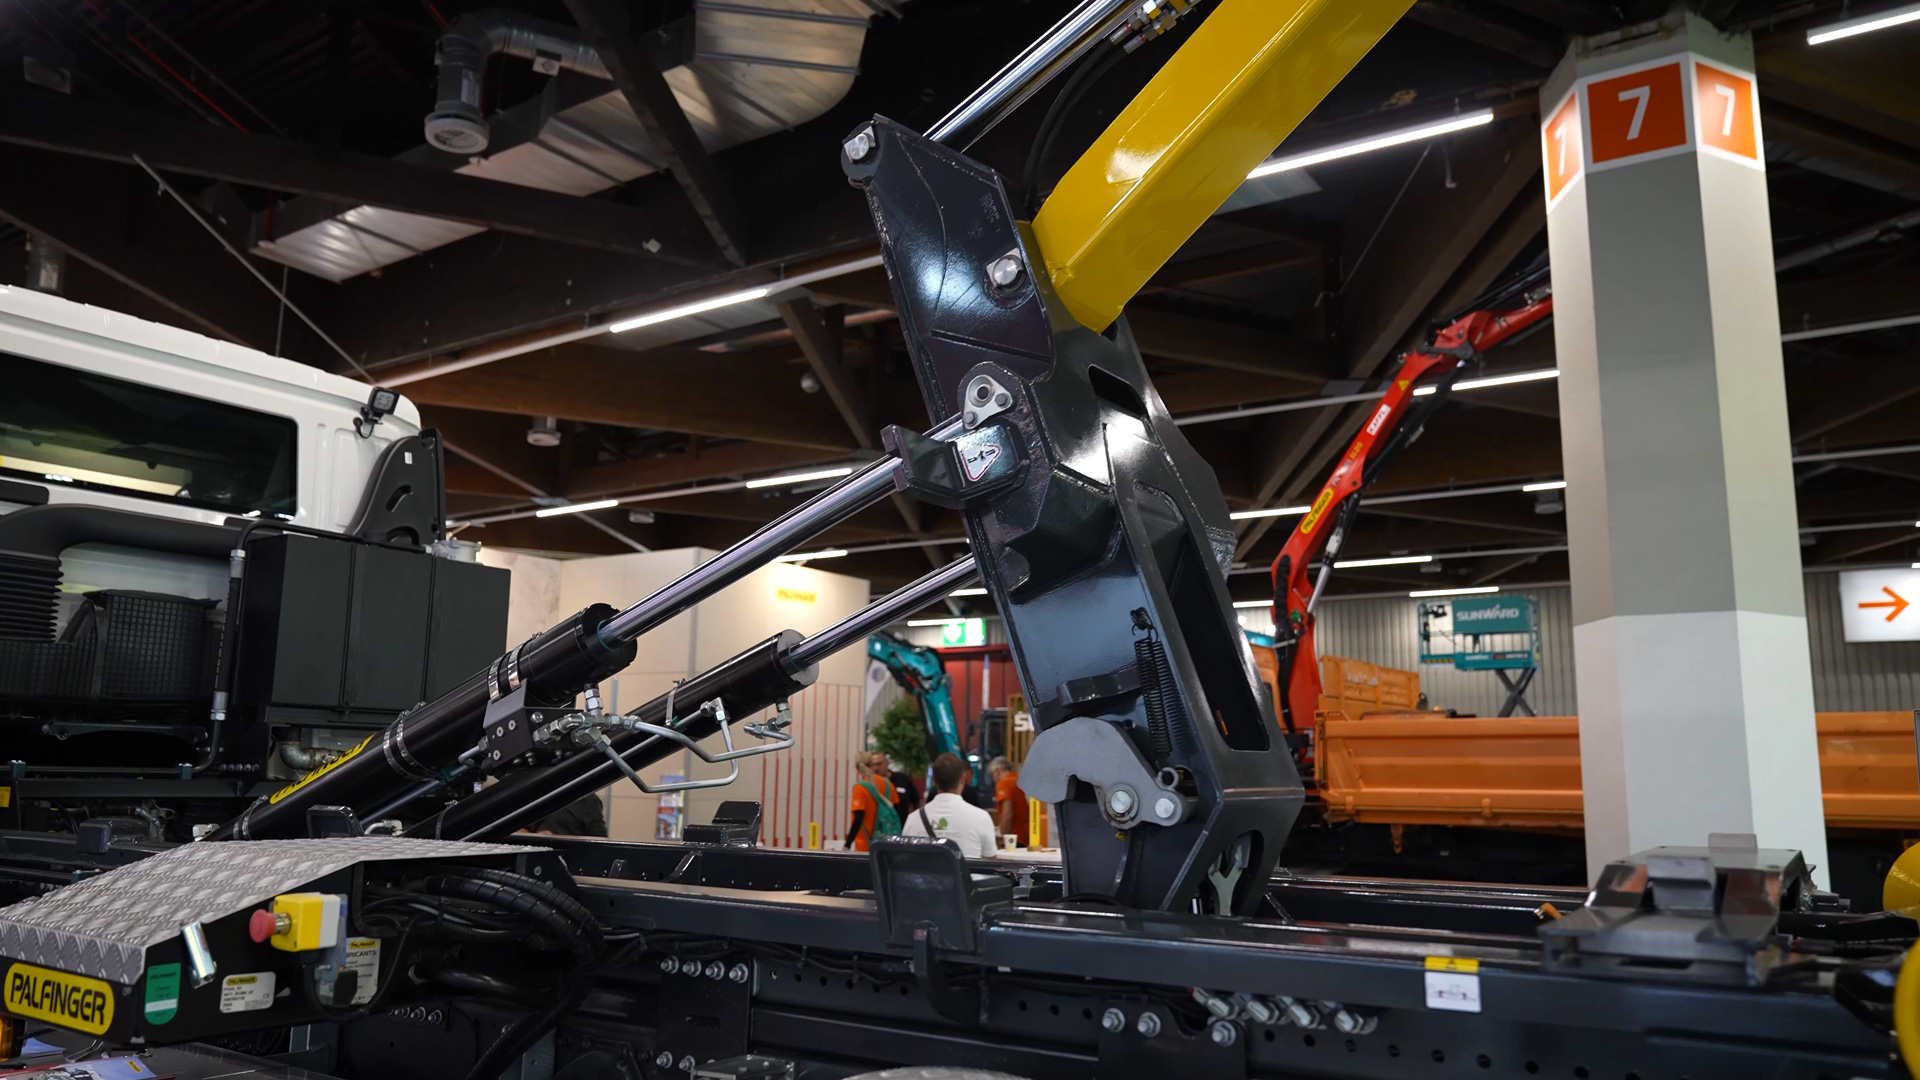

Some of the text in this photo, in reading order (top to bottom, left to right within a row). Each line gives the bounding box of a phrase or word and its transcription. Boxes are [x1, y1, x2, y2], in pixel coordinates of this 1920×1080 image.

[1618, 85, 1650, 140] 7
[1715, 83, 1735, 136] 7
[1457, 604, 1520, 621] SUNWARD
[10, 973, 106, 1025] PALFINGER
